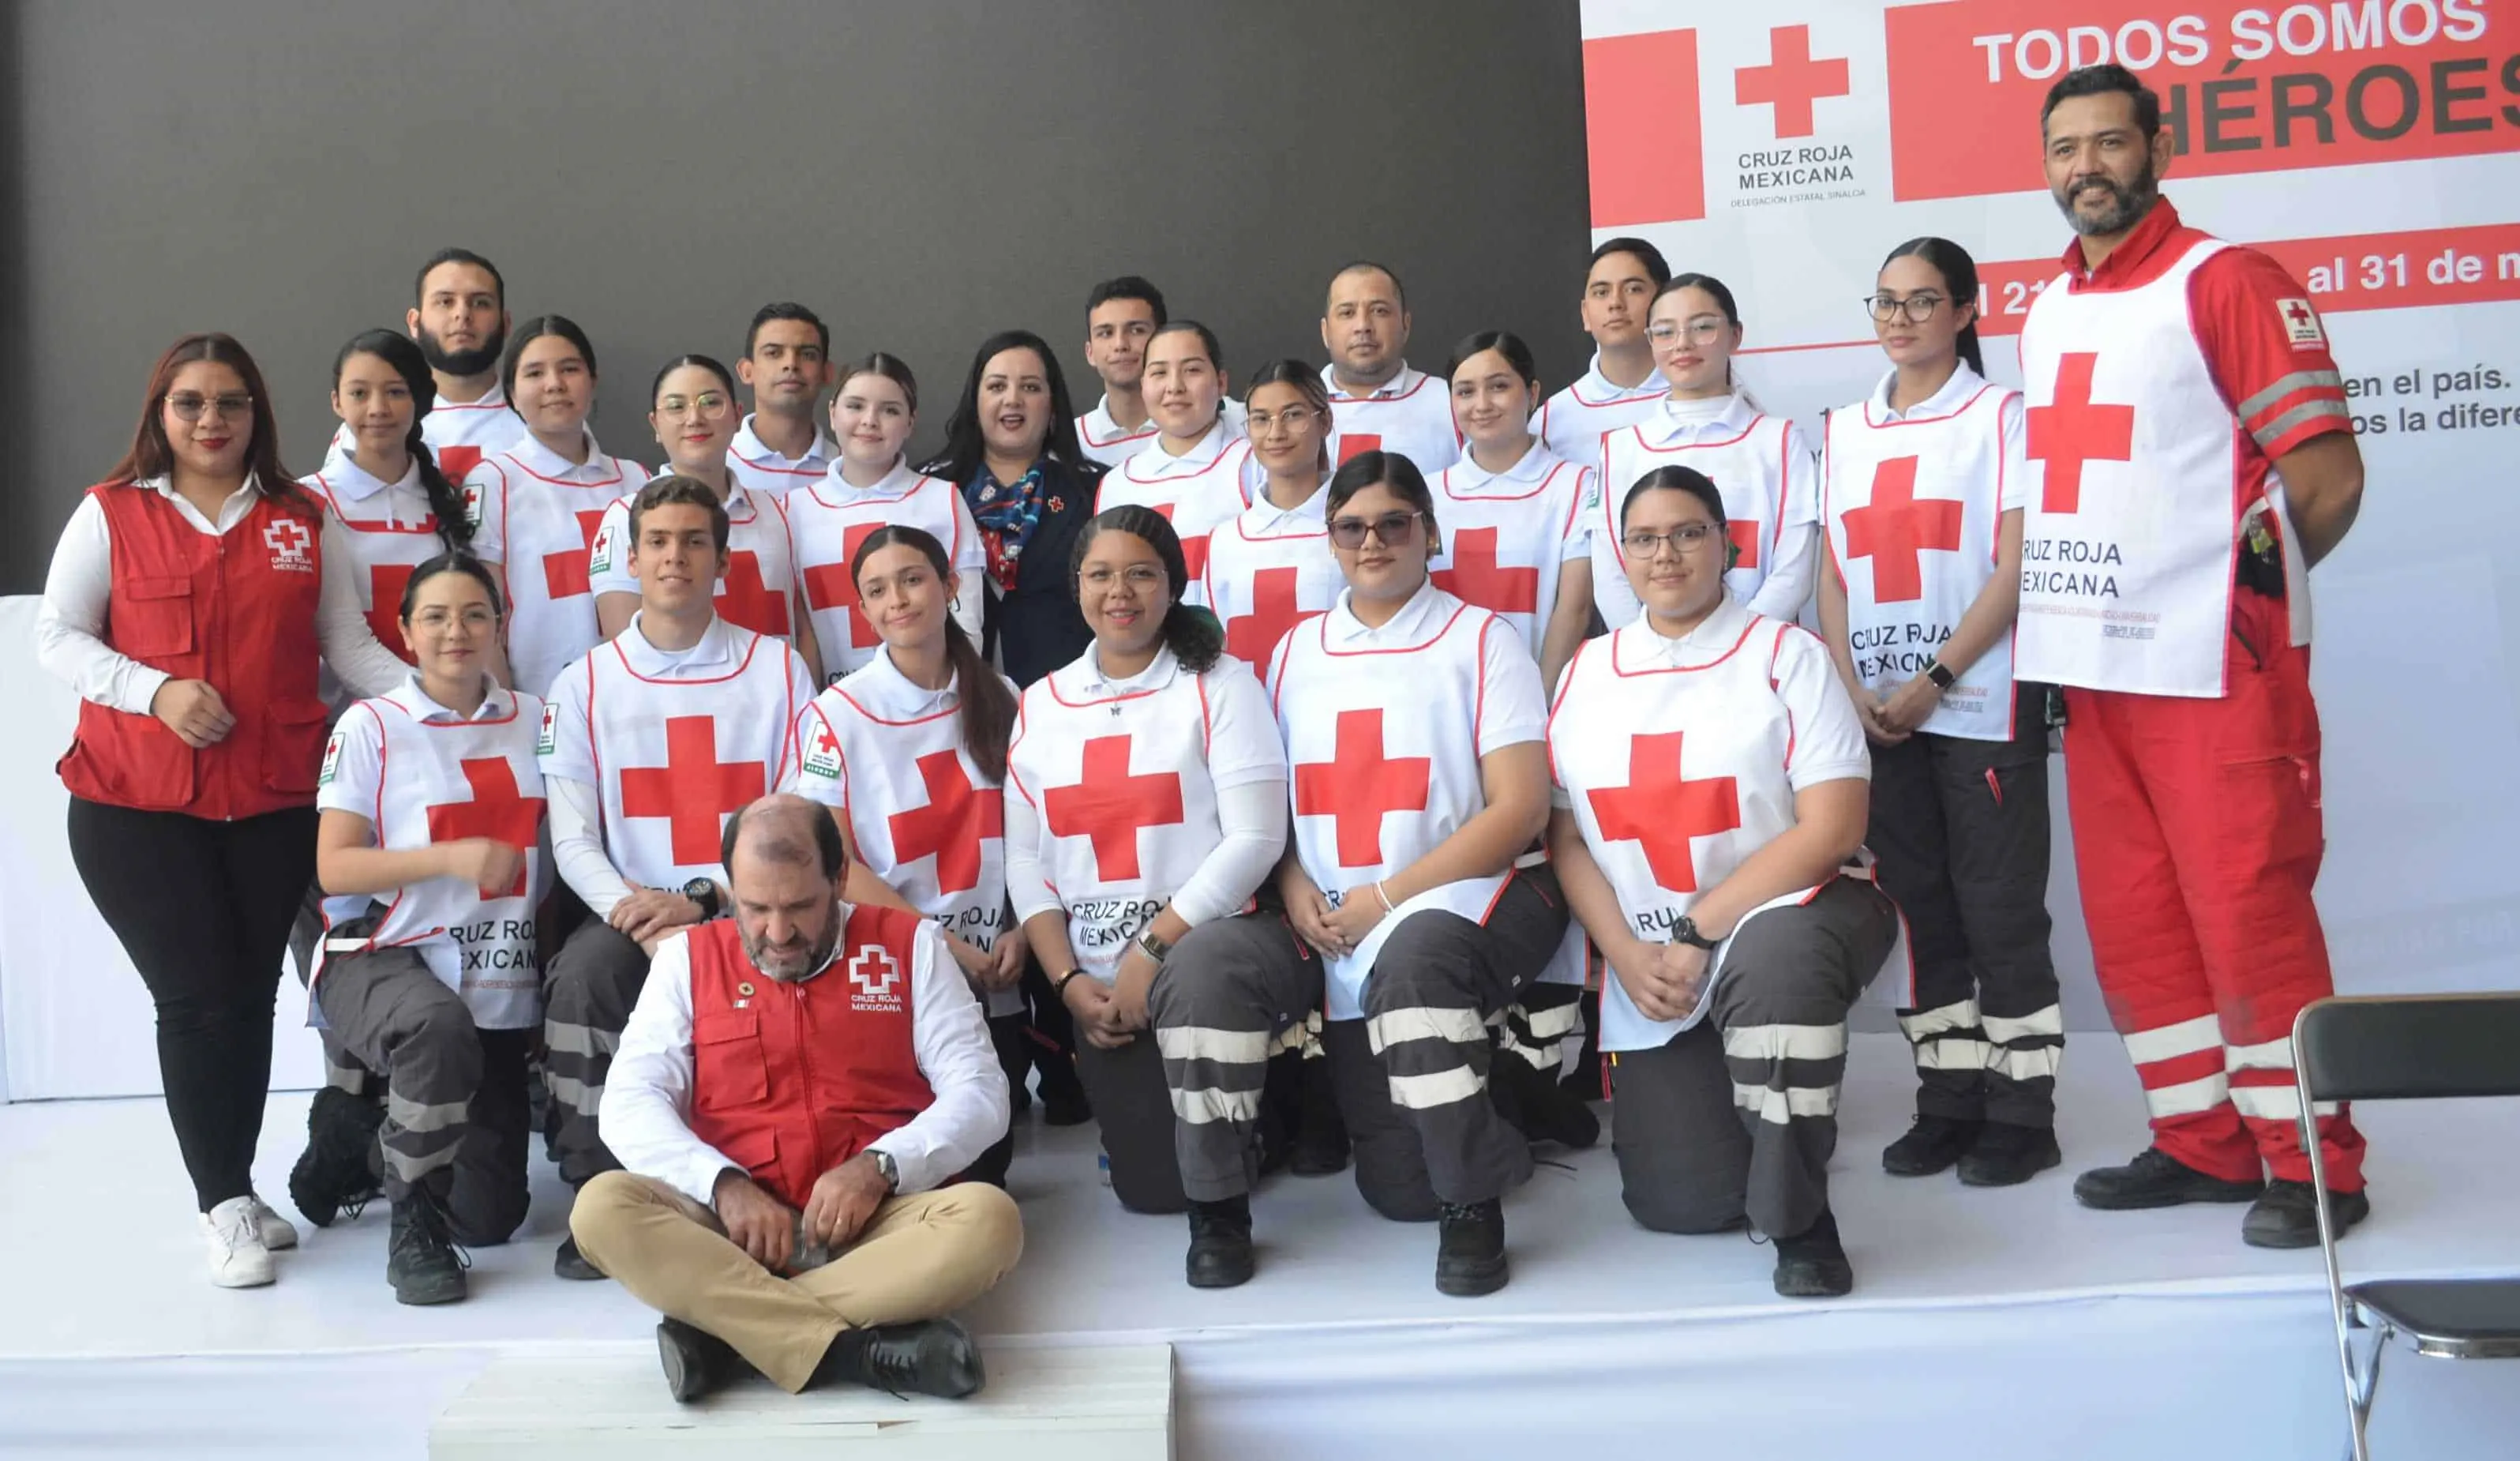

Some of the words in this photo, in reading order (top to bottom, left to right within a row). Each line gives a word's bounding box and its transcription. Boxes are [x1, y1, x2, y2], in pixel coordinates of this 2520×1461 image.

[1973, 16, 2208, 82] TODOS
[2230, 0, 2486, 60] SOMOS
[1738, 150, 1793, 169] CRUZ
[1798, 145, 1853, 163] ROJA
[1739, 165, 1854, 190] MEXICANA
[2308, 257, 2344, 293] al
[2361, 254, 2406, 289] 31
[2427, 250, 2482, 285] de
[2346, 377, 2381, 397] en
[2394, 370, 2420, 395] el
[2433, 364, 2511, 399] país.
[2399, 408, 2425, 432] la
[2023, 539, 2051, 561] RUZ
[2058, 540, 2122, 565] ROJA
[2022, 571, 2119, 598] EXICANA
[1851, 625, 1899, 650] CUZ
[1072, 901, 1121, 921] CRUZ
[449, 920, 496, 945] RUZ
[503, 919, 536, 941] RO
